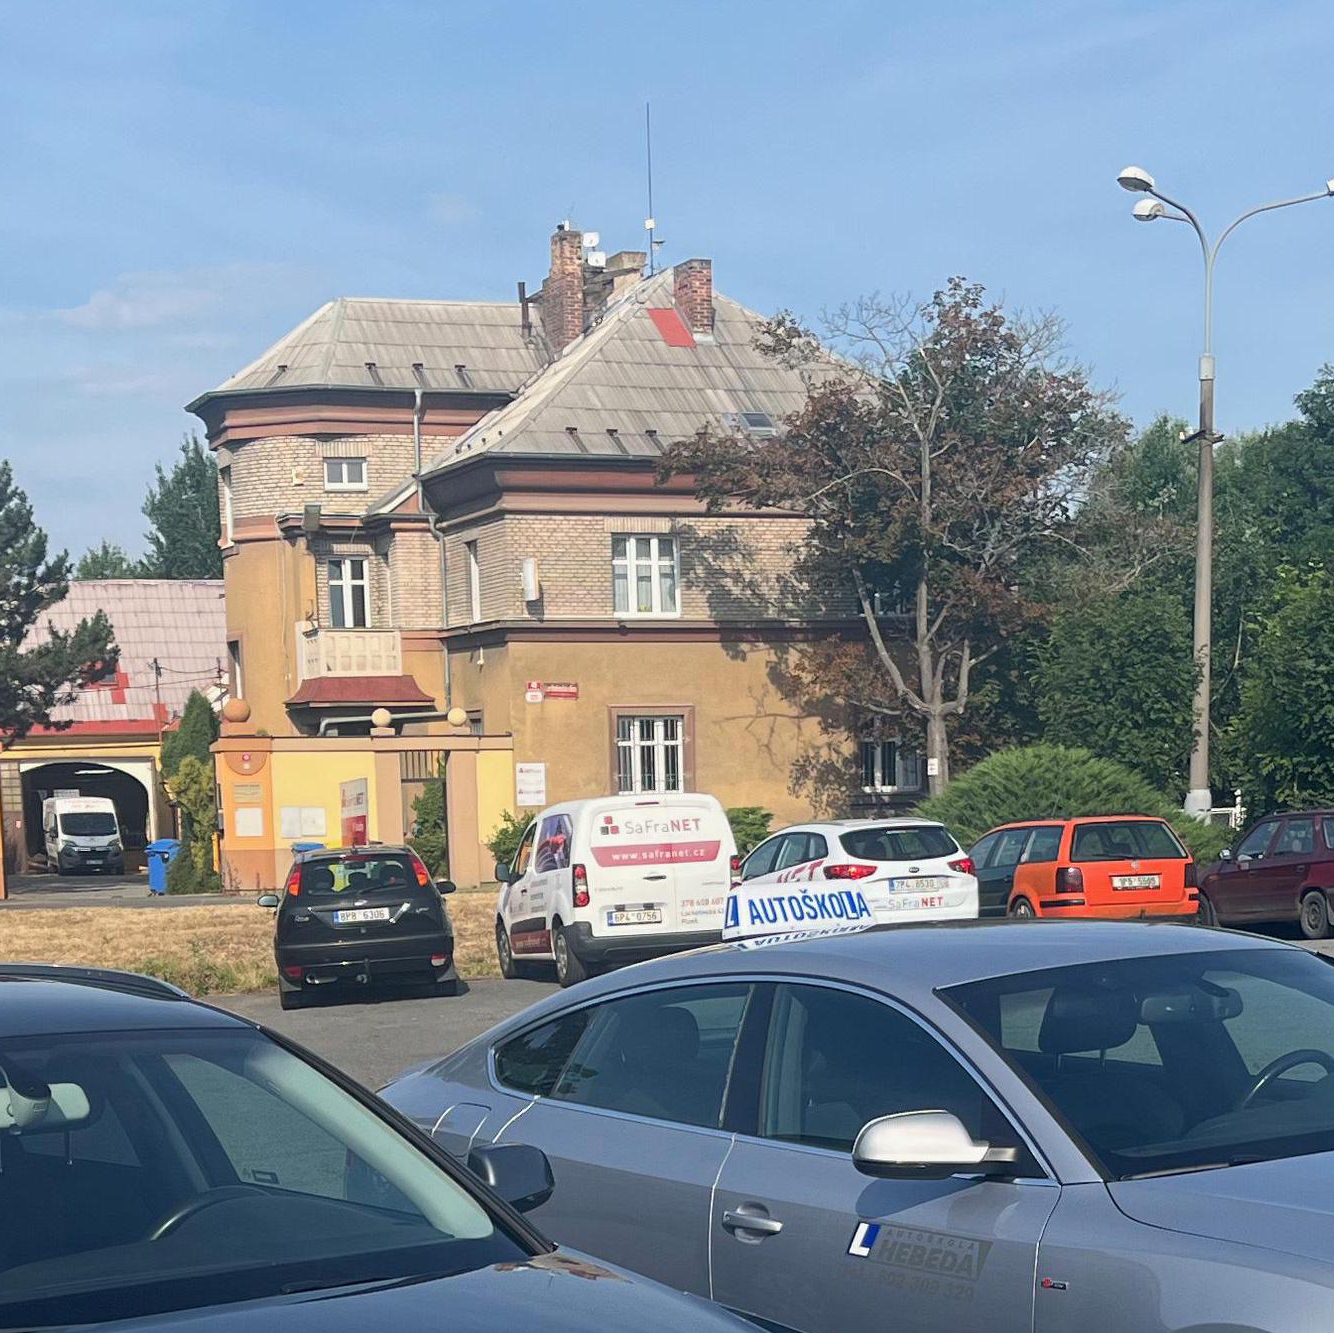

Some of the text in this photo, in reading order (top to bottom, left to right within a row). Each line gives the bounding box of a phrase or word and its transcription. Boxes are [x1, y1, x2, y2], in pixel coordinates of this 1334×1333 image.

[624, 818, 701, 835] SaFraNET
[611, 848, 706, 861] www.safranet.cz
[748, 889, 871, 925] AUTOŠKOLA
[877, 1239, 973, 1277] HEBEDA
